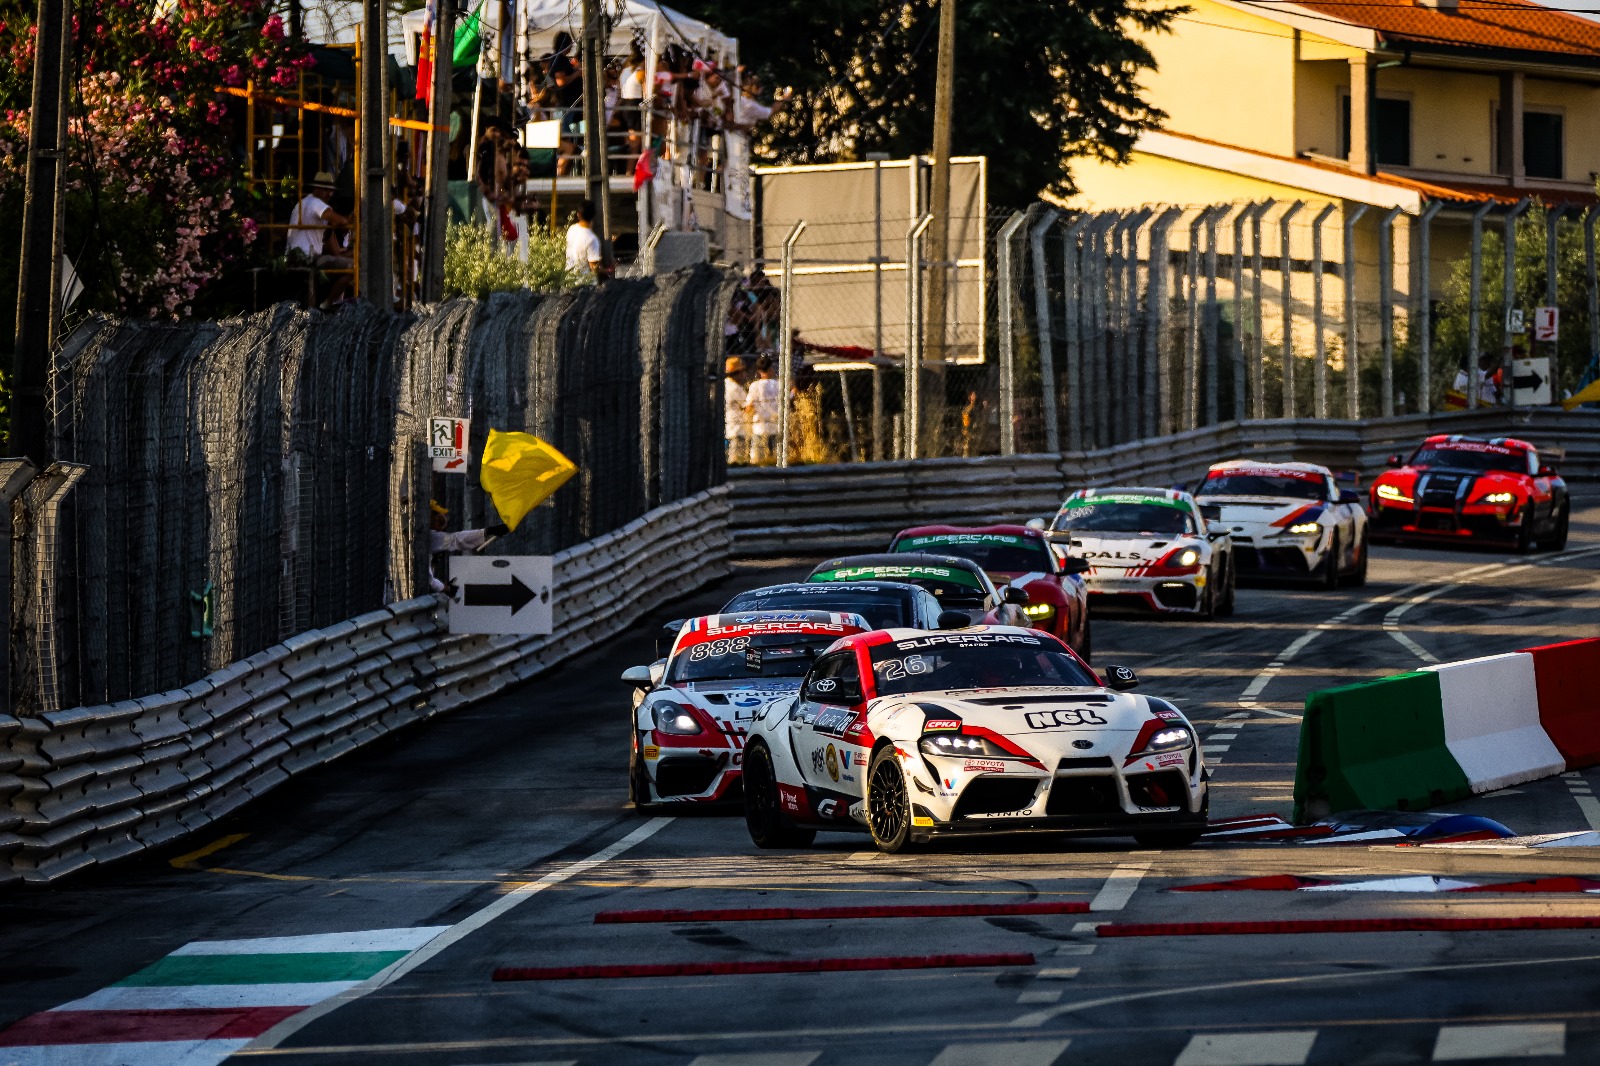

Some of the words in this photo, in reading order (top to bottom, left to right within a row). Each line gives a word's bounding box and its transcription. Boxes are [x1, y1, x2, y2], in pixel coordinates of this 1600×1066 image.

[433, 447, 453, 457] EXIT
[913, 534, 1017, 545] SUPERCARS
[835, 566, 950, 578] SUPERCARS
[756, 586, 879, 597] SUPERCARS
[707, 622, 844, 636] SUPERCARS
[690, 636, 751, 662] 888
[896, 635, 1042, 651] SUPERCARS
[884, 654, 927, 681] 26
[927, 720, 957, 728] CPKA
[1024, 709, 1108, 729] NGL
[986, 809, 1033, 818] KINTO
